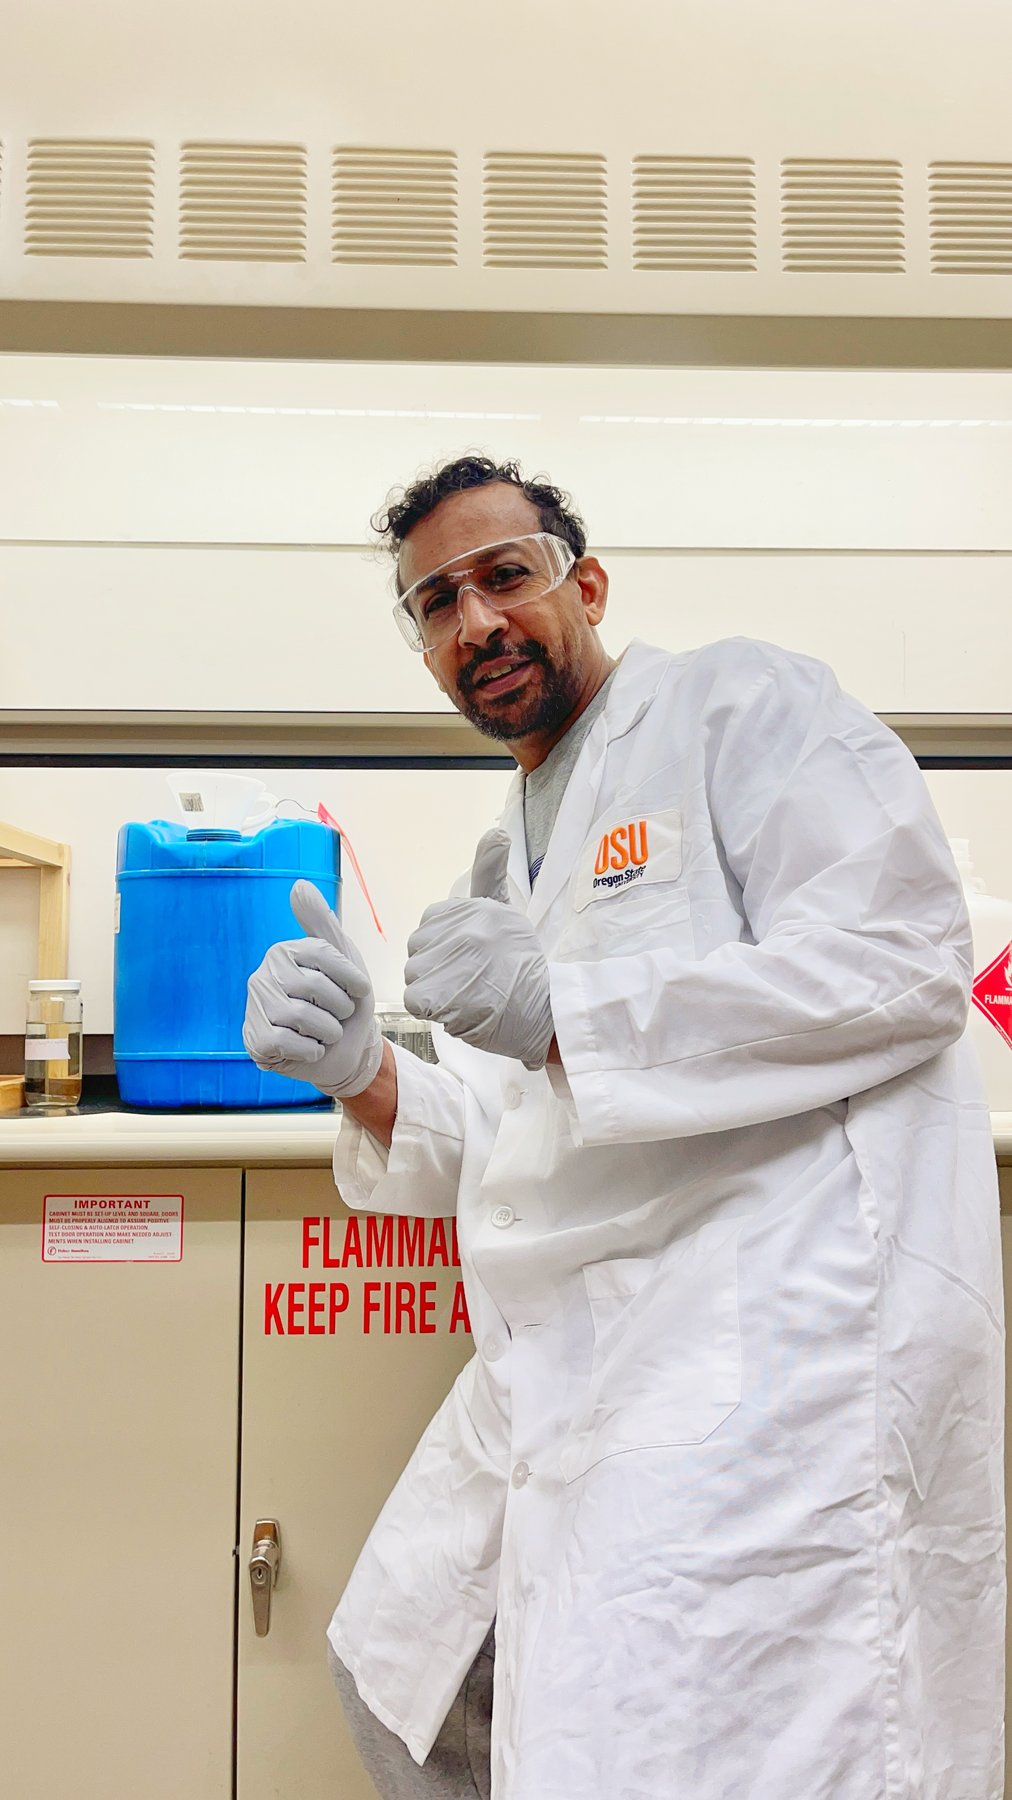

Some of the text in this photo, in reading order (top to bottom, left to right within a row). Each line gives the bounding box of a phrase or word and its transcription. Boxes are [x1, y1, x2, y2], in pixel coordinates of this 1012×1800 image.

[594, 820, 648, 875] OSU
[593, 874, 624, 888] Oregon
[74, 1200, 151, 1209] IMPORTANT
[264, 1283, 349, 1335] KEEP
[364, 1282, 436, 1334] FIRE
